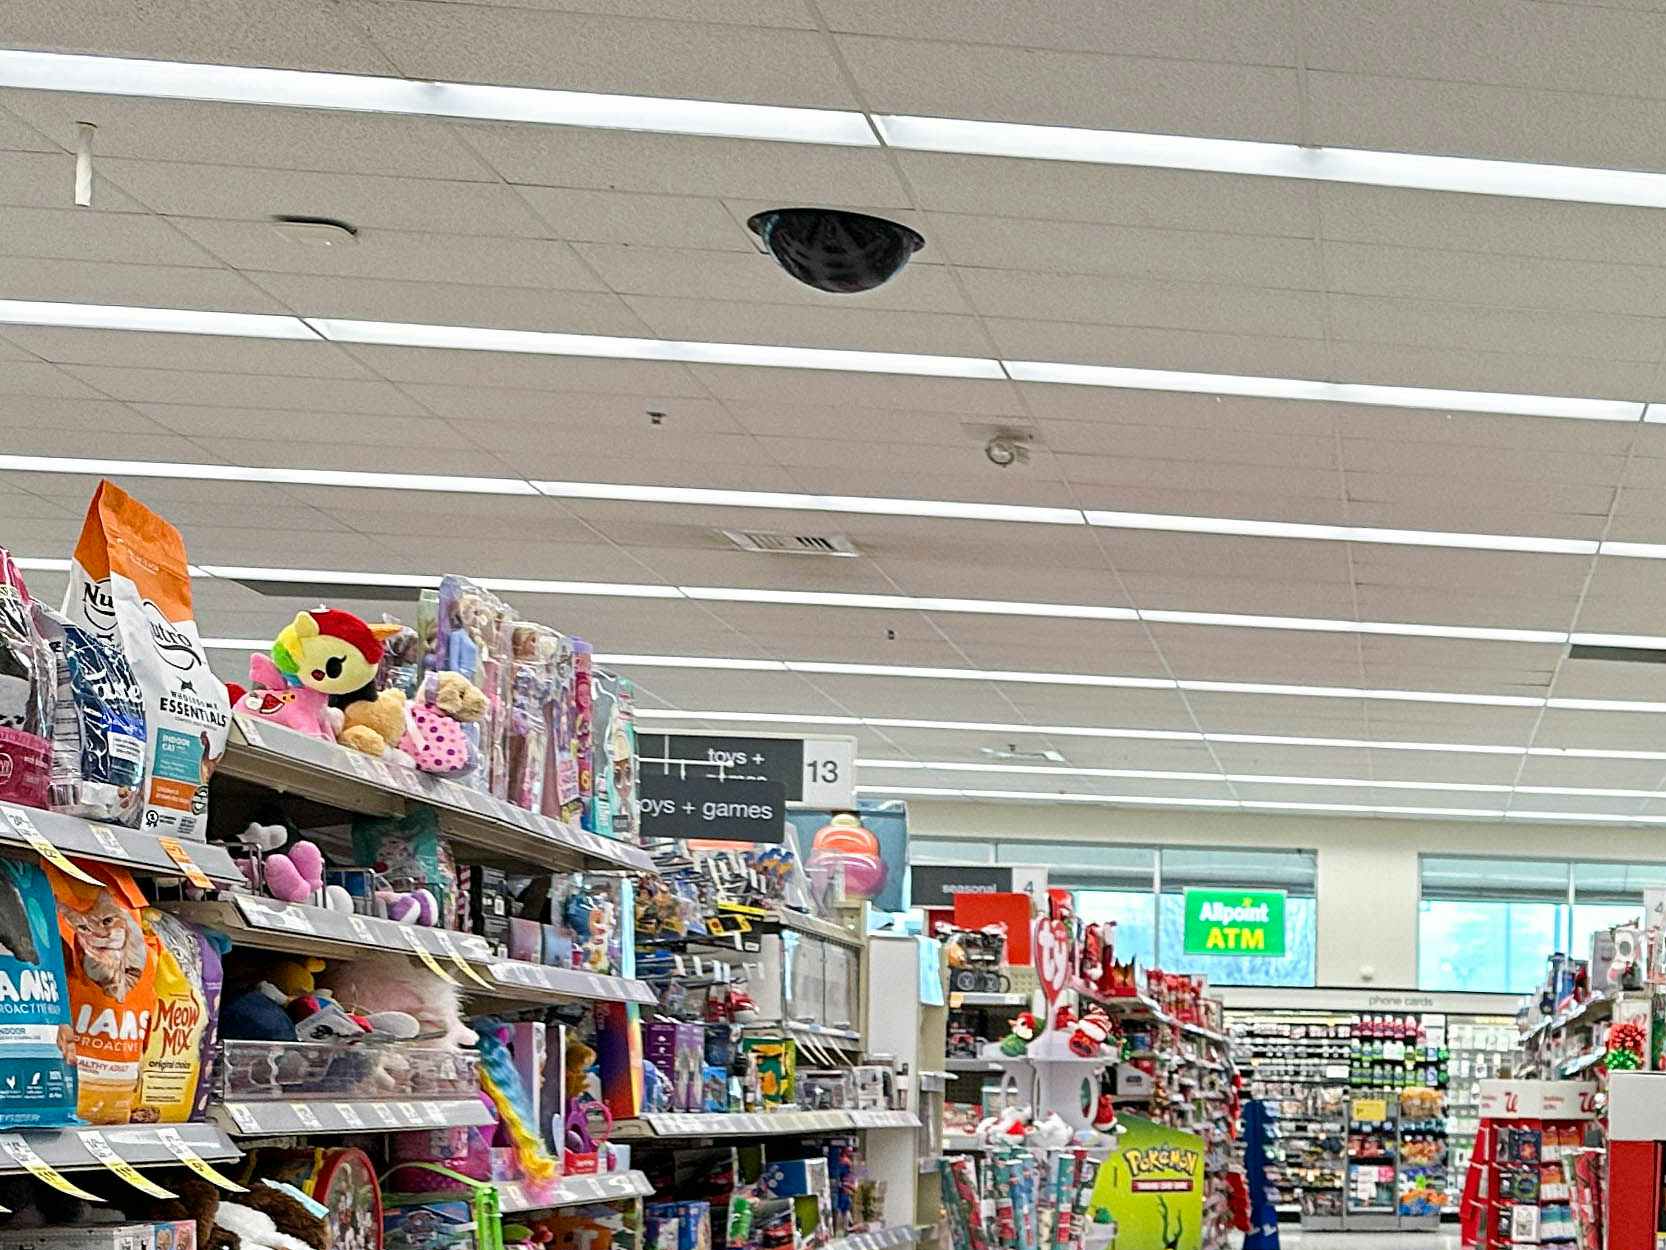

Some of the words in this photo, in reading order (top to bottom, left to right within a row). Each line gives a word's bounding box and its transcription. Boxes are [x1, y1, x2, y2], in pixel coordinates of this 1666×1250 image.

[149, 621, 193, 648] utro
[160, 698, 227, 728] ESSENTIALS
[707, 748, 746, 766] toys
[807, 760, 838, 783] 13
[682, 802, 696, 815] +
[703, 801, 773, 820] games
[1199, 899, 1269, 926] Allpoint
[1206, 927, 1265, 950] ATM
[0, 969, 57, 1002] AMS
[78, 1059, 108, 1071] ALTHY
